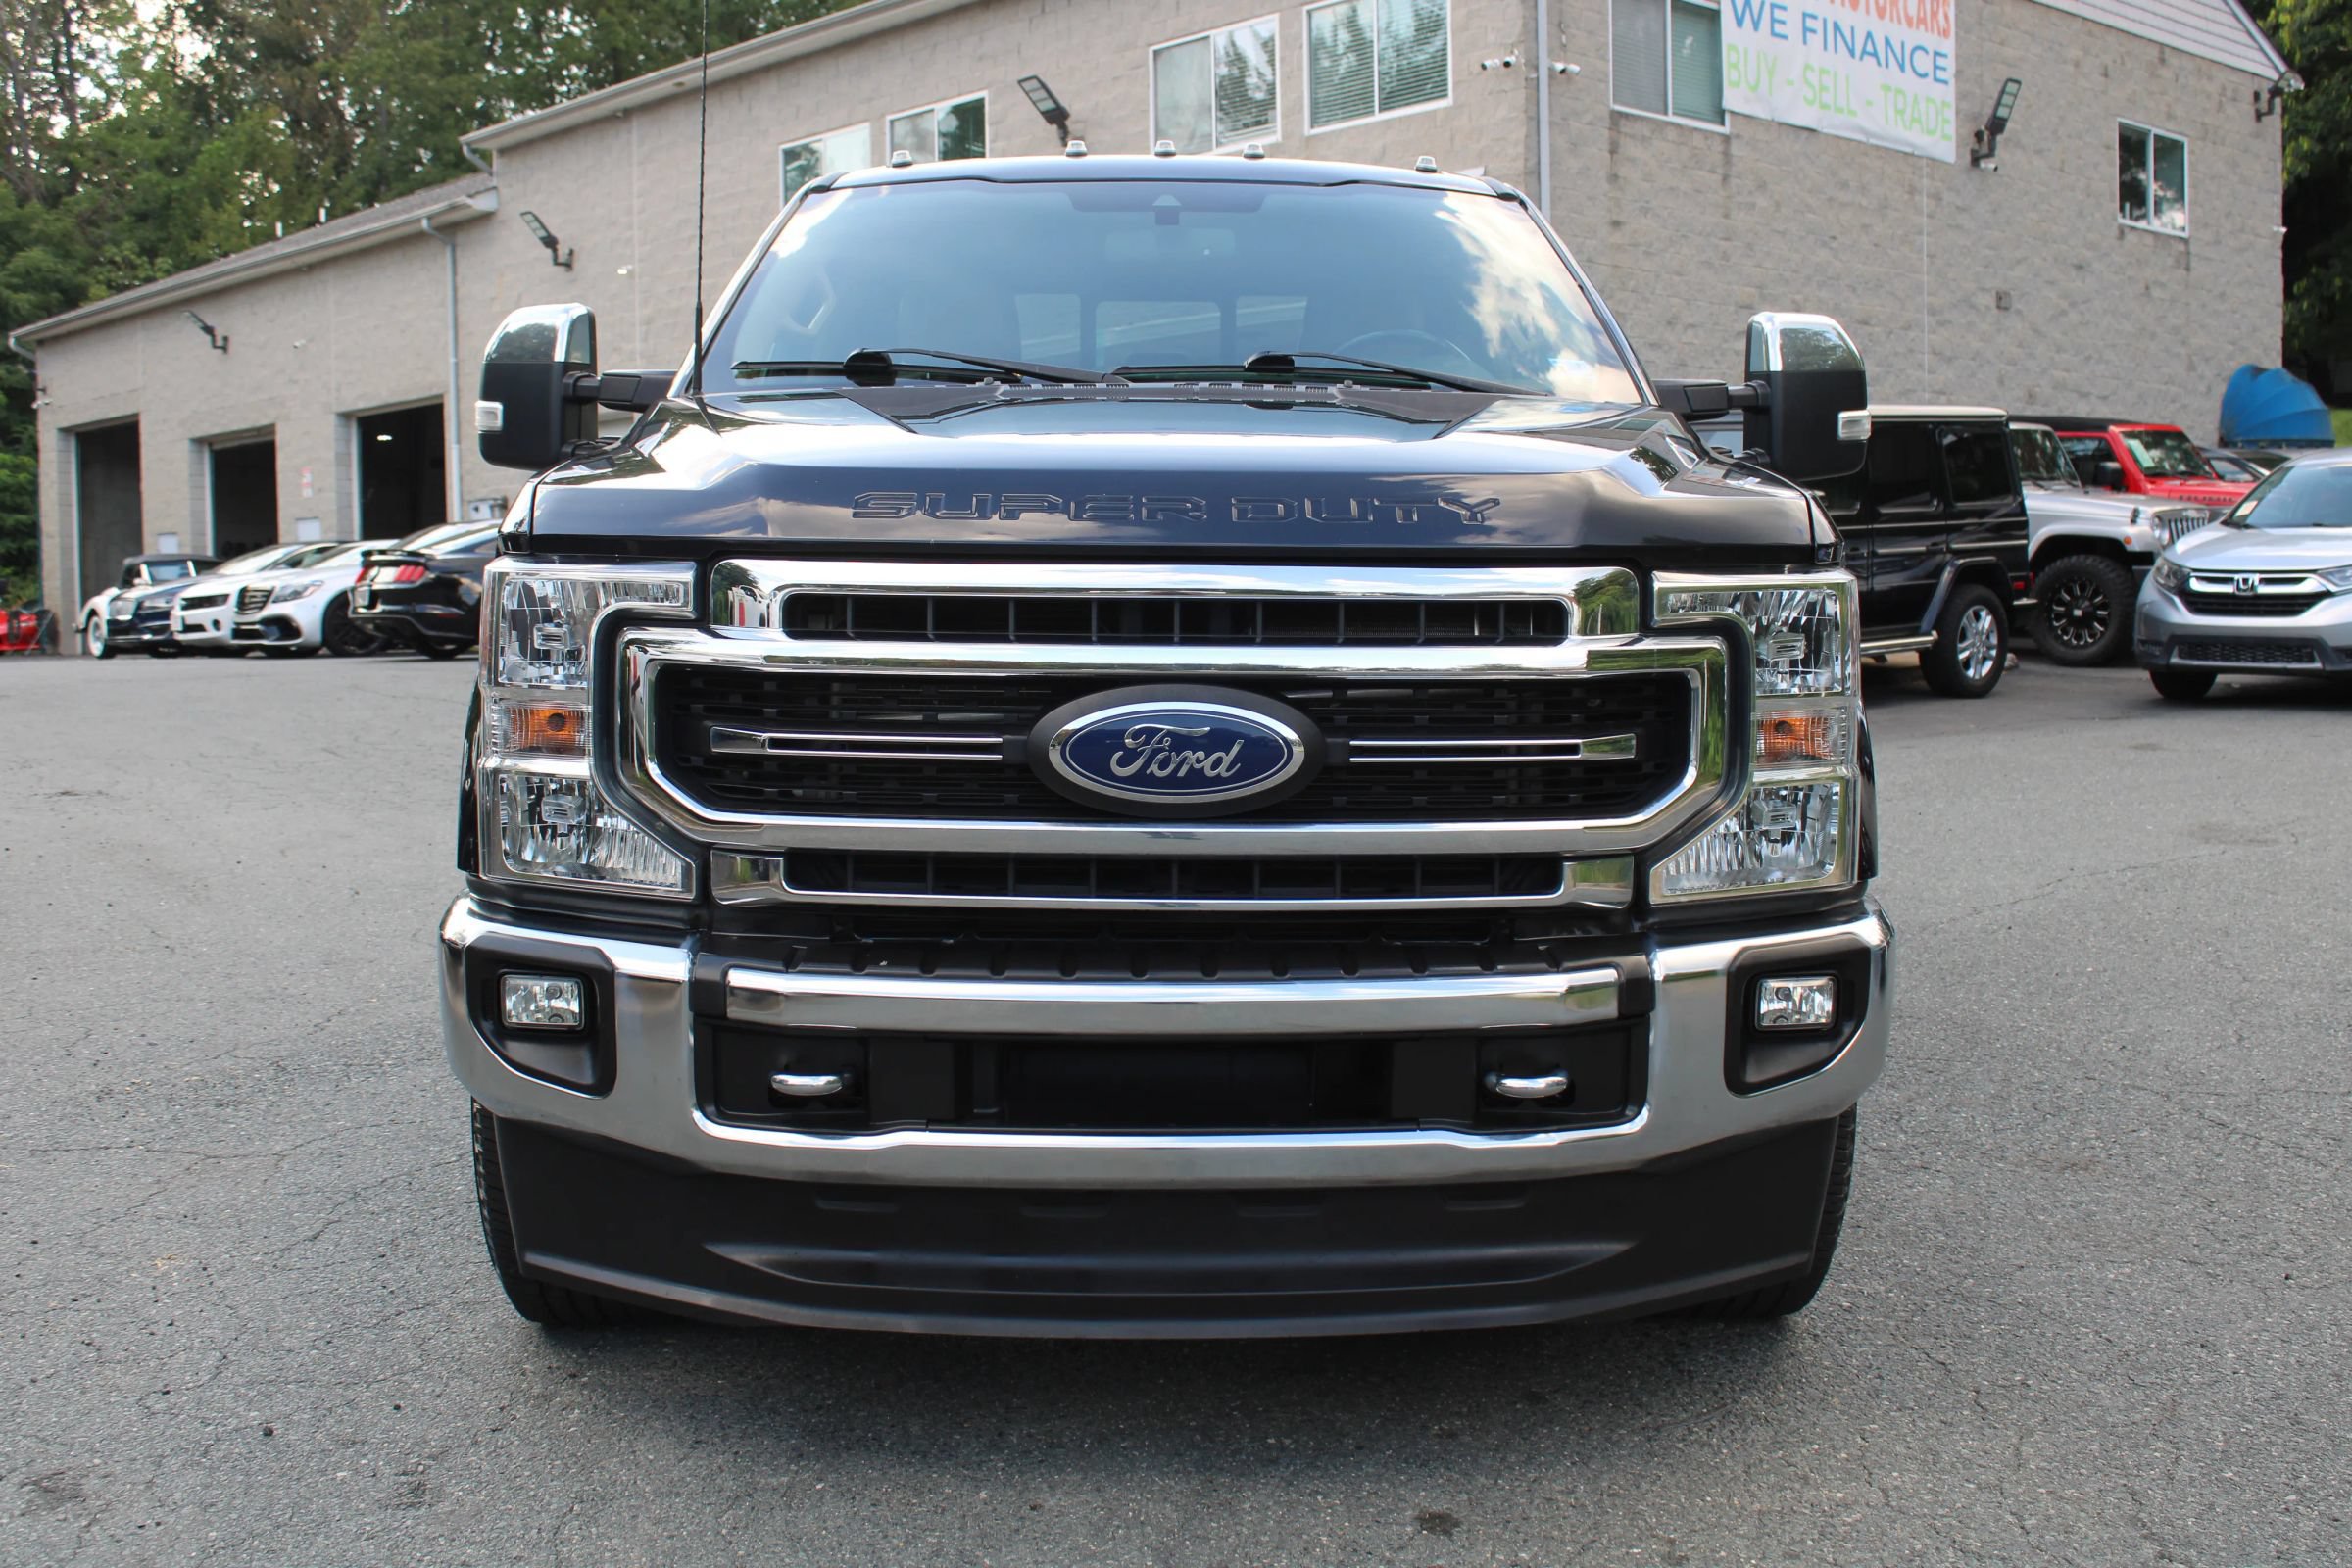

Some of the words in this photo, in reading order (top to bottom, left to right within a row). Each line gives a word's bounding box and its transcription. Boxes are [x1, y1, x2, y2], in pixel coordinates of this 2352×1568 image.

[1731, 0, 1788, 40] WE
[1802, 11, 1949, 85] FINANCE
[1830, 0, 1951, 39] RCARS
[1726, 44, 1778, 96] BUY
[1802, 62, 1858, 118] SELL
[1880, 83, 1953, 142] TRADE
[852, 492, 1208, 521] SUPER
[1231, 497, 1500, 524] DUTY
[1109, 723, 1245, 777] Ford
